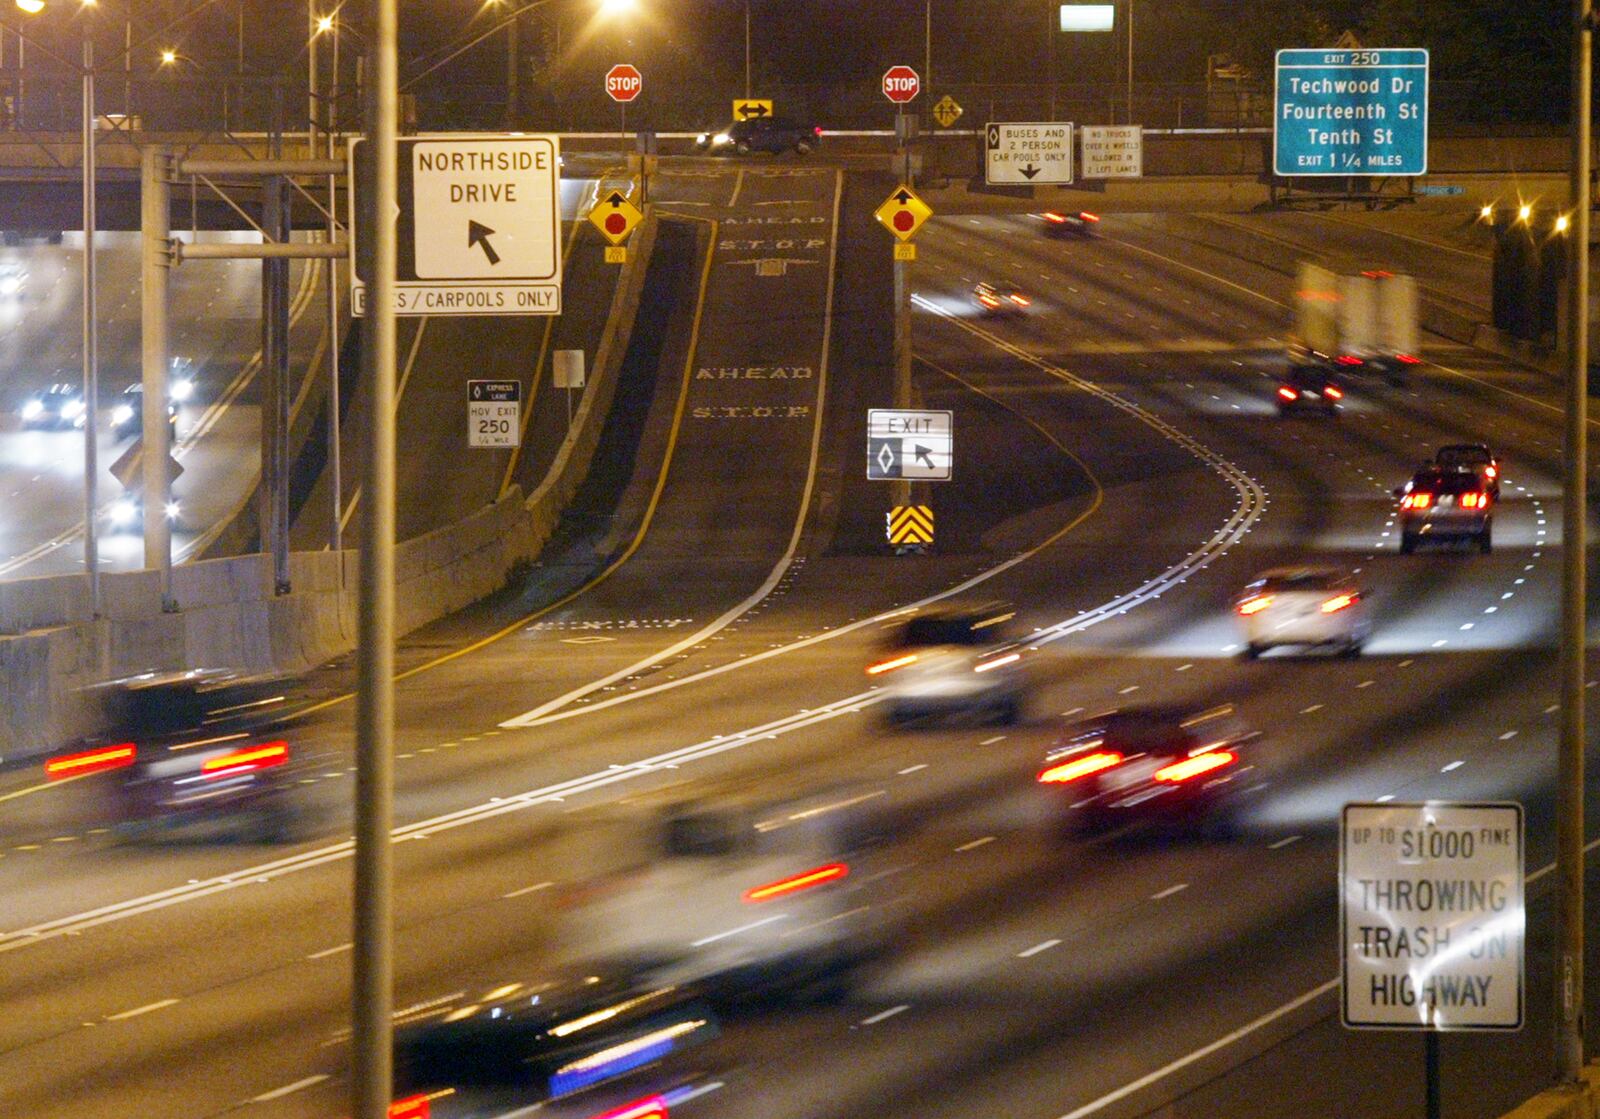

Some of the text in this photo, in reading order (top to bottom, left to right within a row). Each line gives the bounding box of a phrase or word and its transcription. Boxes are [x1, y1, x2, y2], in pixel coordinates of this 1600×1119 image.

[1324, 52, 1380, 65] EXIT 250
[608, 77, 639, 91] STOP
[885, 77, 917, 92] STOP
[1290, 77, 1413, 94] Techwood Dr
[1283, 102, 1418, 120] Fourteenth St
[1006, 128, 1065, 138] BUSES AND
[1308, 128, 1393, 145] Tenth St
[1010, 140, 1061, 150] 2 PERSON
[419, 152, 547, 172] NORTHSIDE
[993, 152, 1066, 162] CAR POOLS ONLY
[1298, 155, 1322, 166] EXIT
[1368, 155, 1403, 166] MILES
[450, 183, 517, 203] DRIVE
[719, 240, 825, 250] STOP
[517, 291, 553, 307] ONLY
[695, 367, 812, 379] AHEAD
[471, 407, 516, 416] HOV EXIT
[692, 406, 809, 418] STOP
[479, 420, 510, 434] 250
[888, 418, 933, 433] EXIT
[1353, 828, 1371, 844] UP
[1379, 827, 1395, 844] TO
[1481, 827, 1512, 845] FINE
[1359, 879, 1507, 912] THROWING
[1359, 926, 1449, 959] TRASH
[1371, 974, 1493, 1007] HIGHWAY
